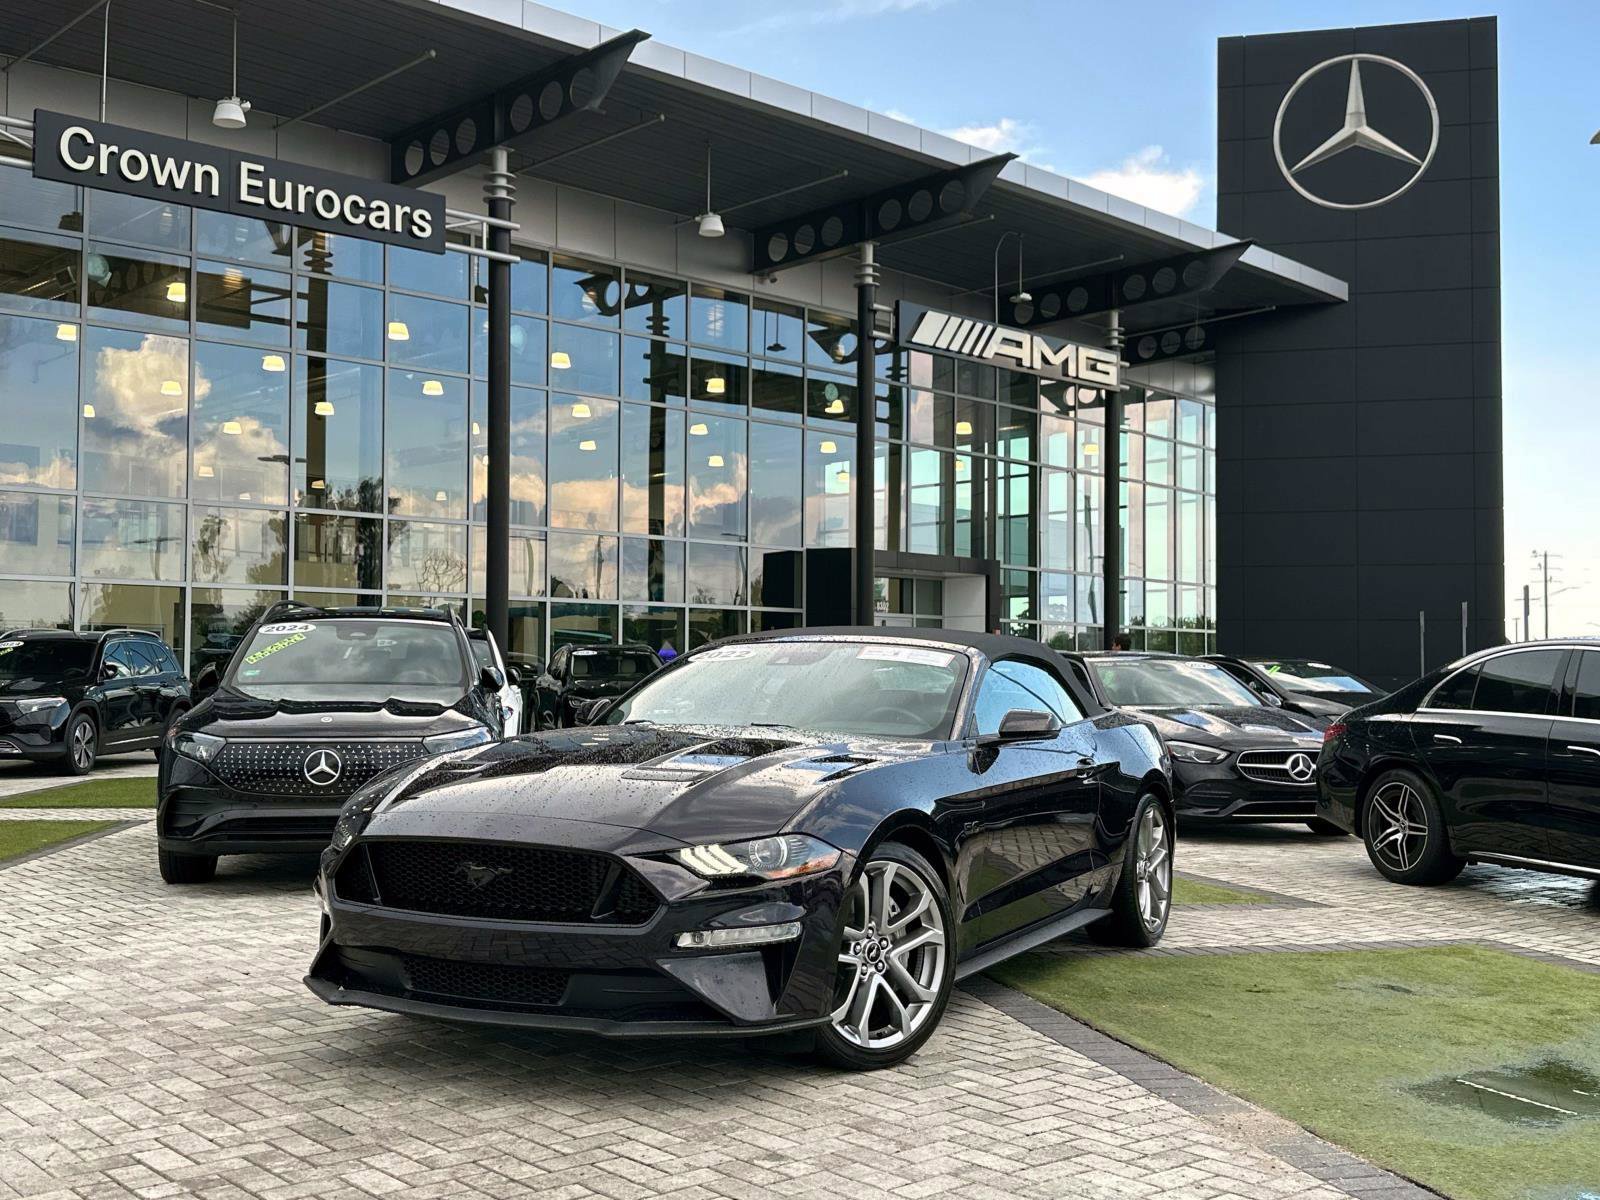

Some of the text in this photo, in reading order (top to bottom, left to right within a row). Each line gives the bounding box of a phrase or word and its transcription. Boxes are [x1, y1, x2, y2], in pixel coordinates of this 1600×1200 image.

[59, 126, 433, 239] Crown Eurocars
[982, 326, 1118, 386] AMG
[264, 624, 310, 633] 2024
[694, 650, 752, 660] 2022
